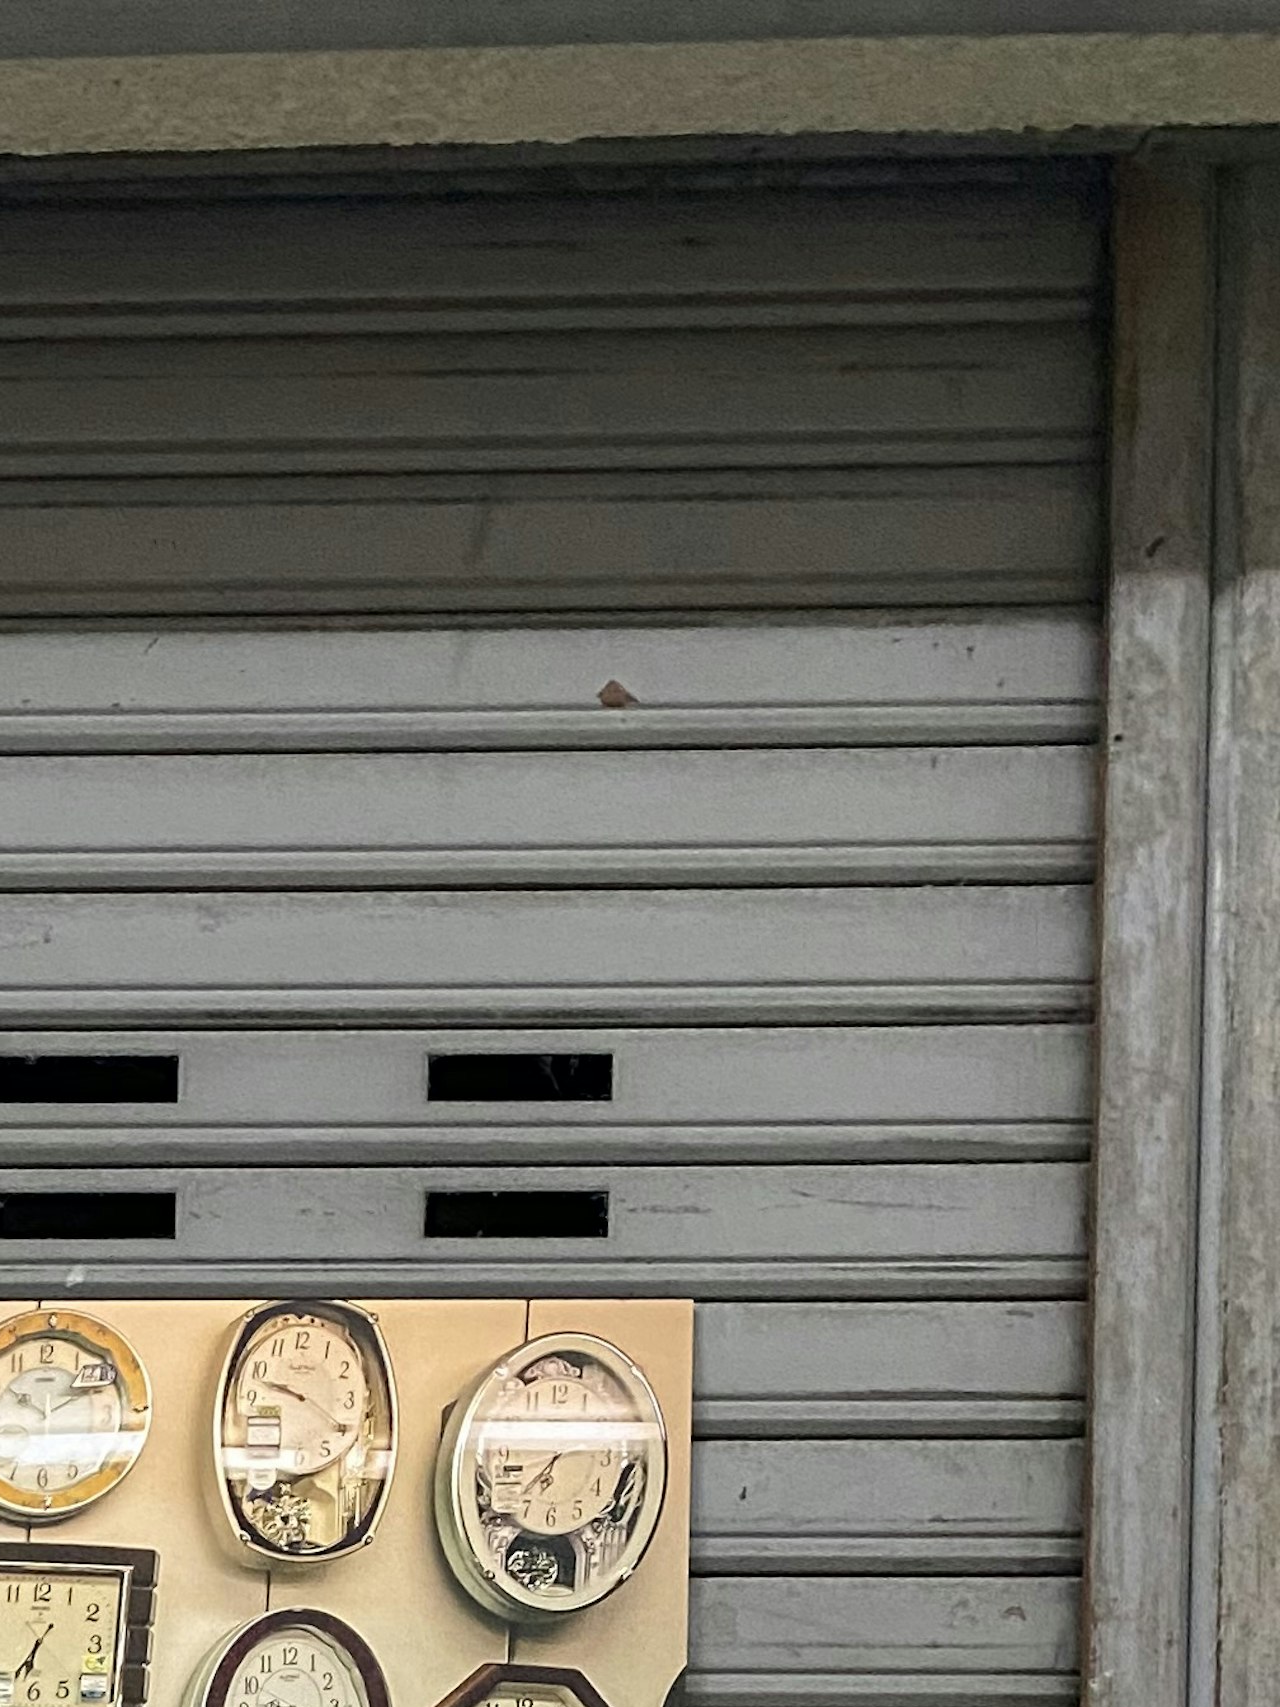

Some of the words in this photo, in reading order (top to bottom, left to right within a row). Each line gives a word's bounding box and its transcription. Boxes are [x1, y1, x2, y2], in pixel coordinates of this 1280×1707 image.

[7, 1585, 19, 1602] 11
[33, 1584, 51, 1601] 12
[68, 1588, 72, 1605] 1
[86, 1603, 99, 1622] 2
[88, 1635, 101, 1654] 3
[261, 1655, 272, 1673] 11
[283, 1647, 297, 1665] 12
[311, 1654, 315, 1671] 1
[56, 1680, 69, 1699] 5
[245, 1676, 259, 1694] 10
[323, 1672, 332, 1690] 2
[27, 1682, 40, 1701] 6
